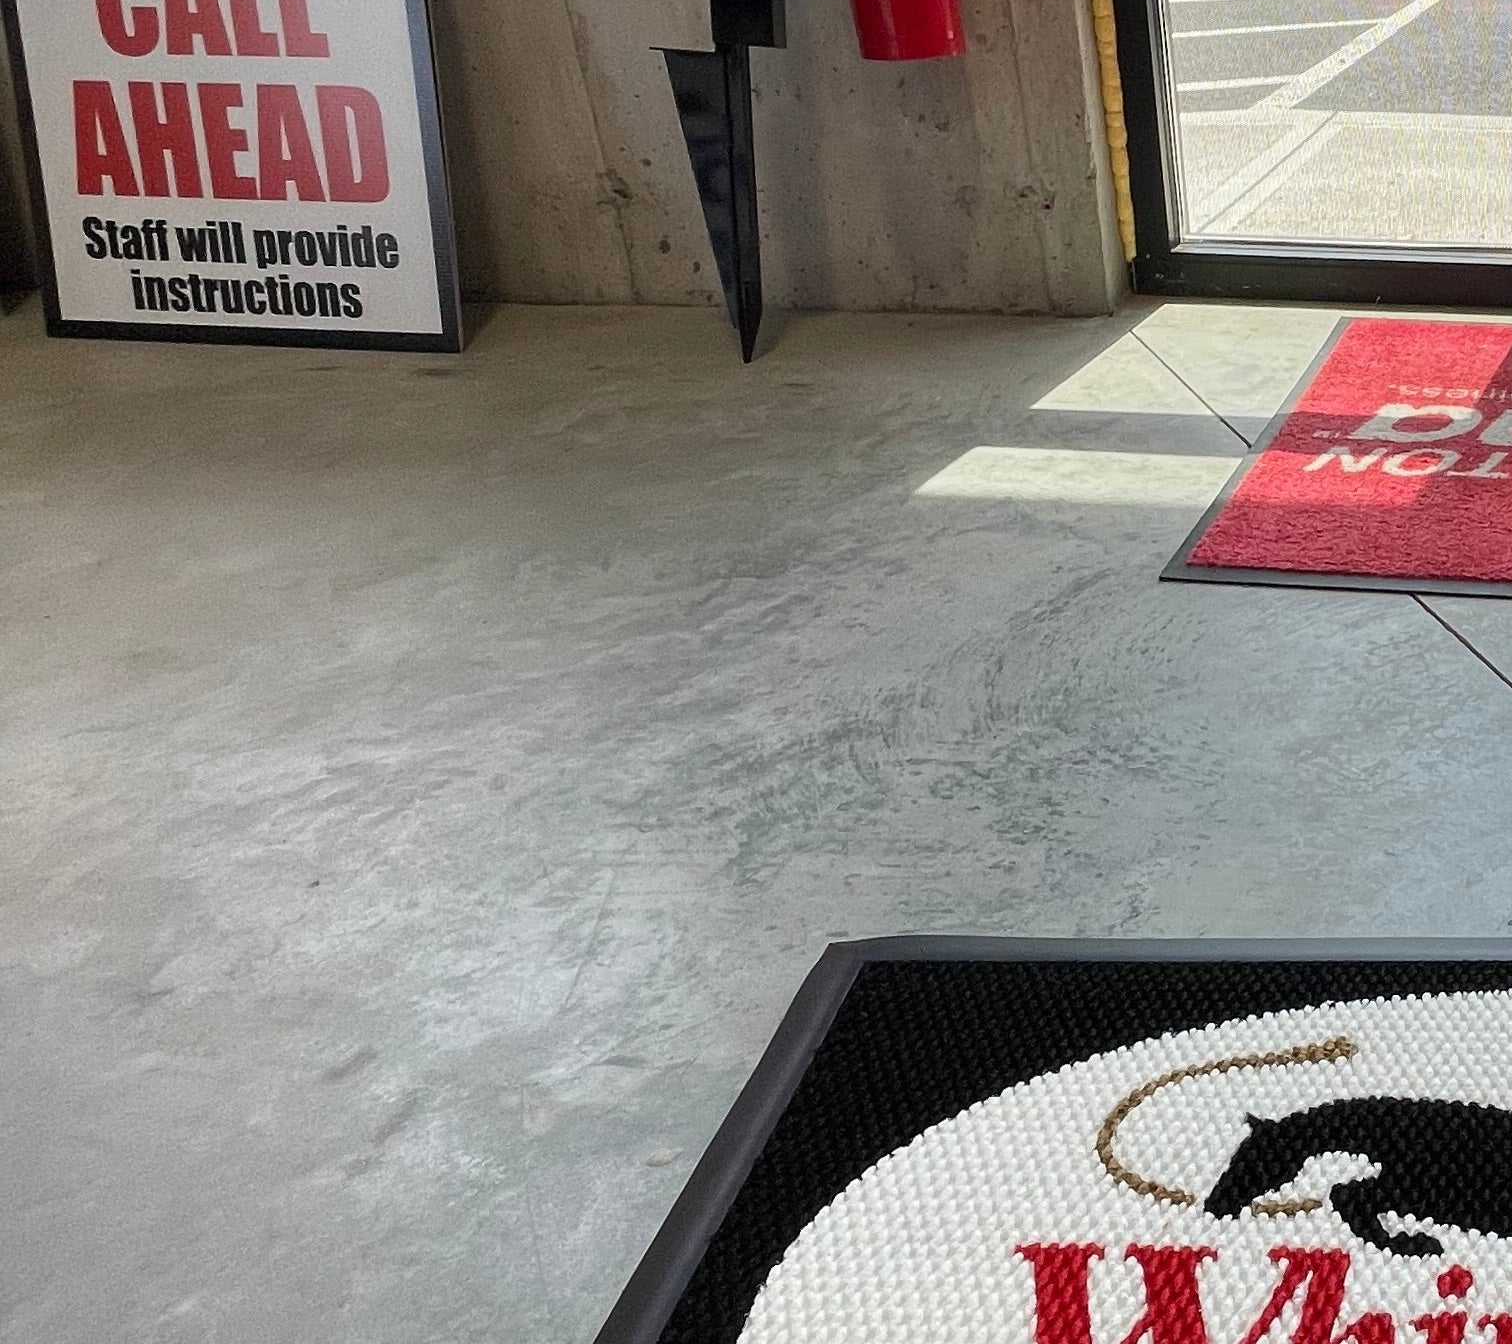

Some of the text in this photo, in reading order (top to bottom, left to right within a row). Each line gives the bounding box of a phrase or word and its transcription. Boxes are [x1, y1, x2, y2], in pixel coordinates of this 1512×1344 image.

[72, 79, 391, 203] AHEAD
[81, 215, 400, 270] Staff will provide
[130, 268, 364, 319] instructions
